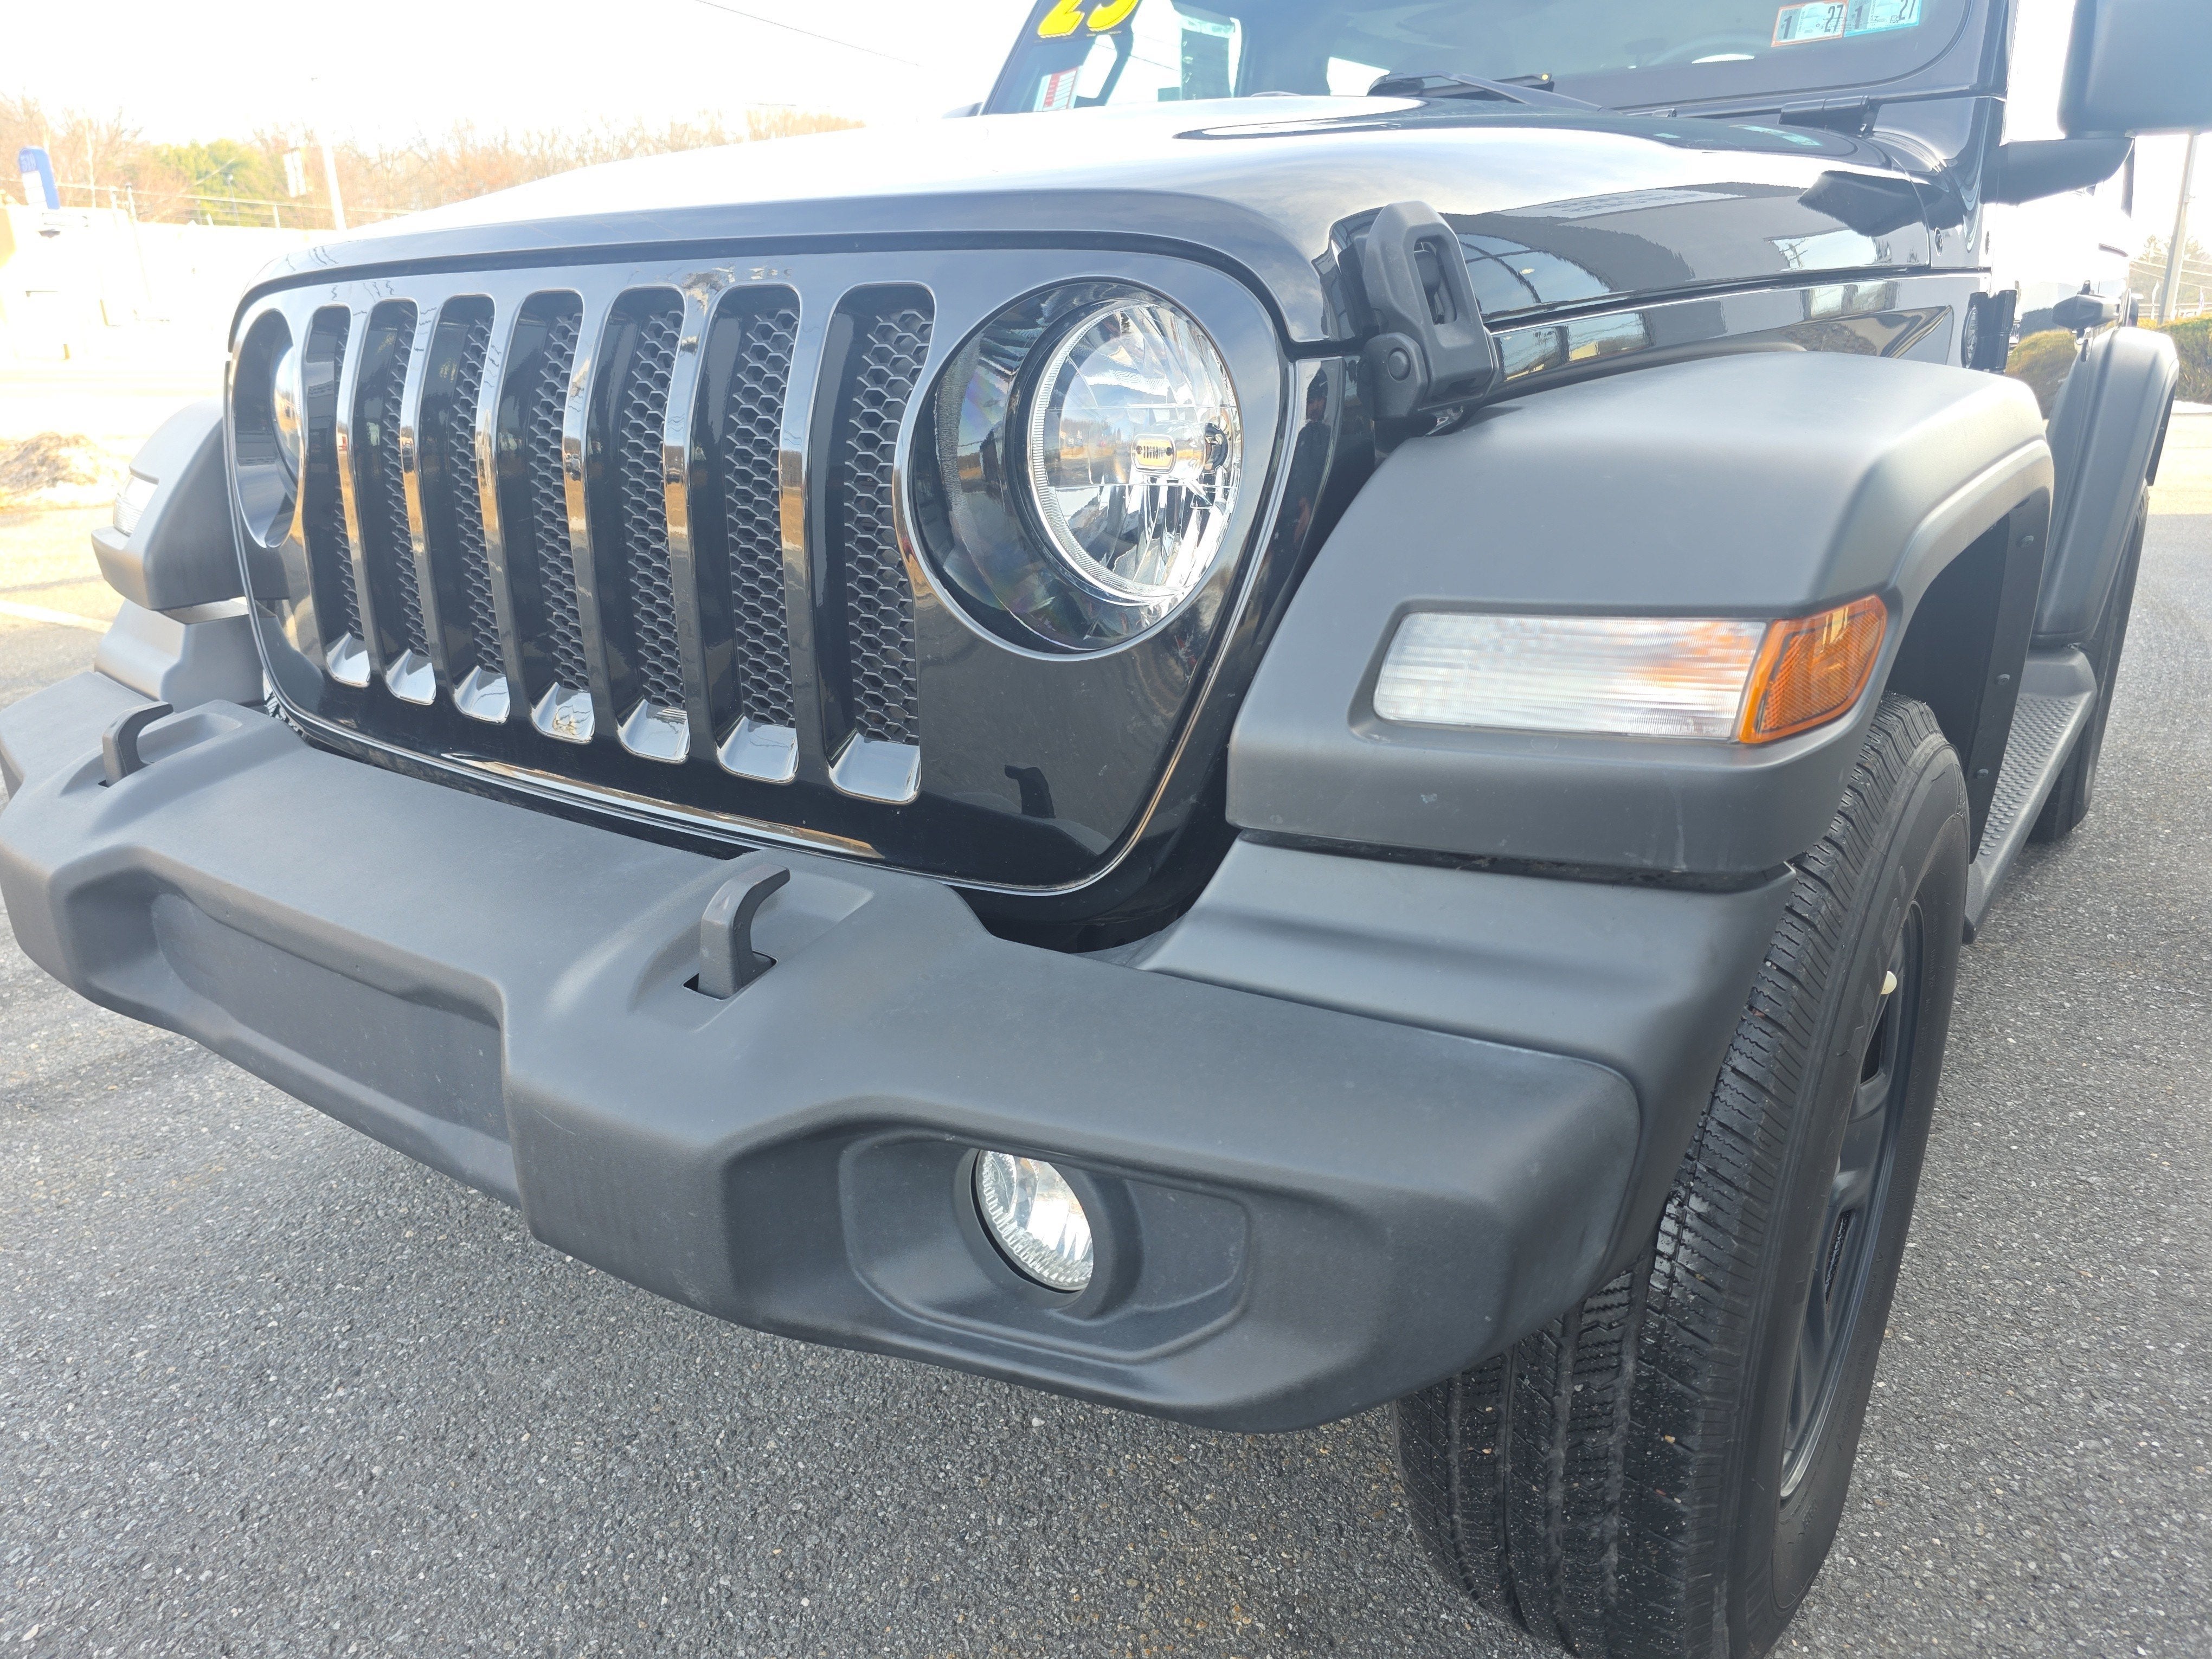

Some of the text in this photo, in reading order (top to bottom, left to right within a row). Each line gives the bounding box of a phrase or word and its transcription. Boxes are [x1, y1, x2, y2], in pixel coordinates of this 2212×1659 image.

[1783, 15, 1793, 40] 1
[1824, 4, 1844, 34] 27
[1854, 5, 1863, 29] 1
